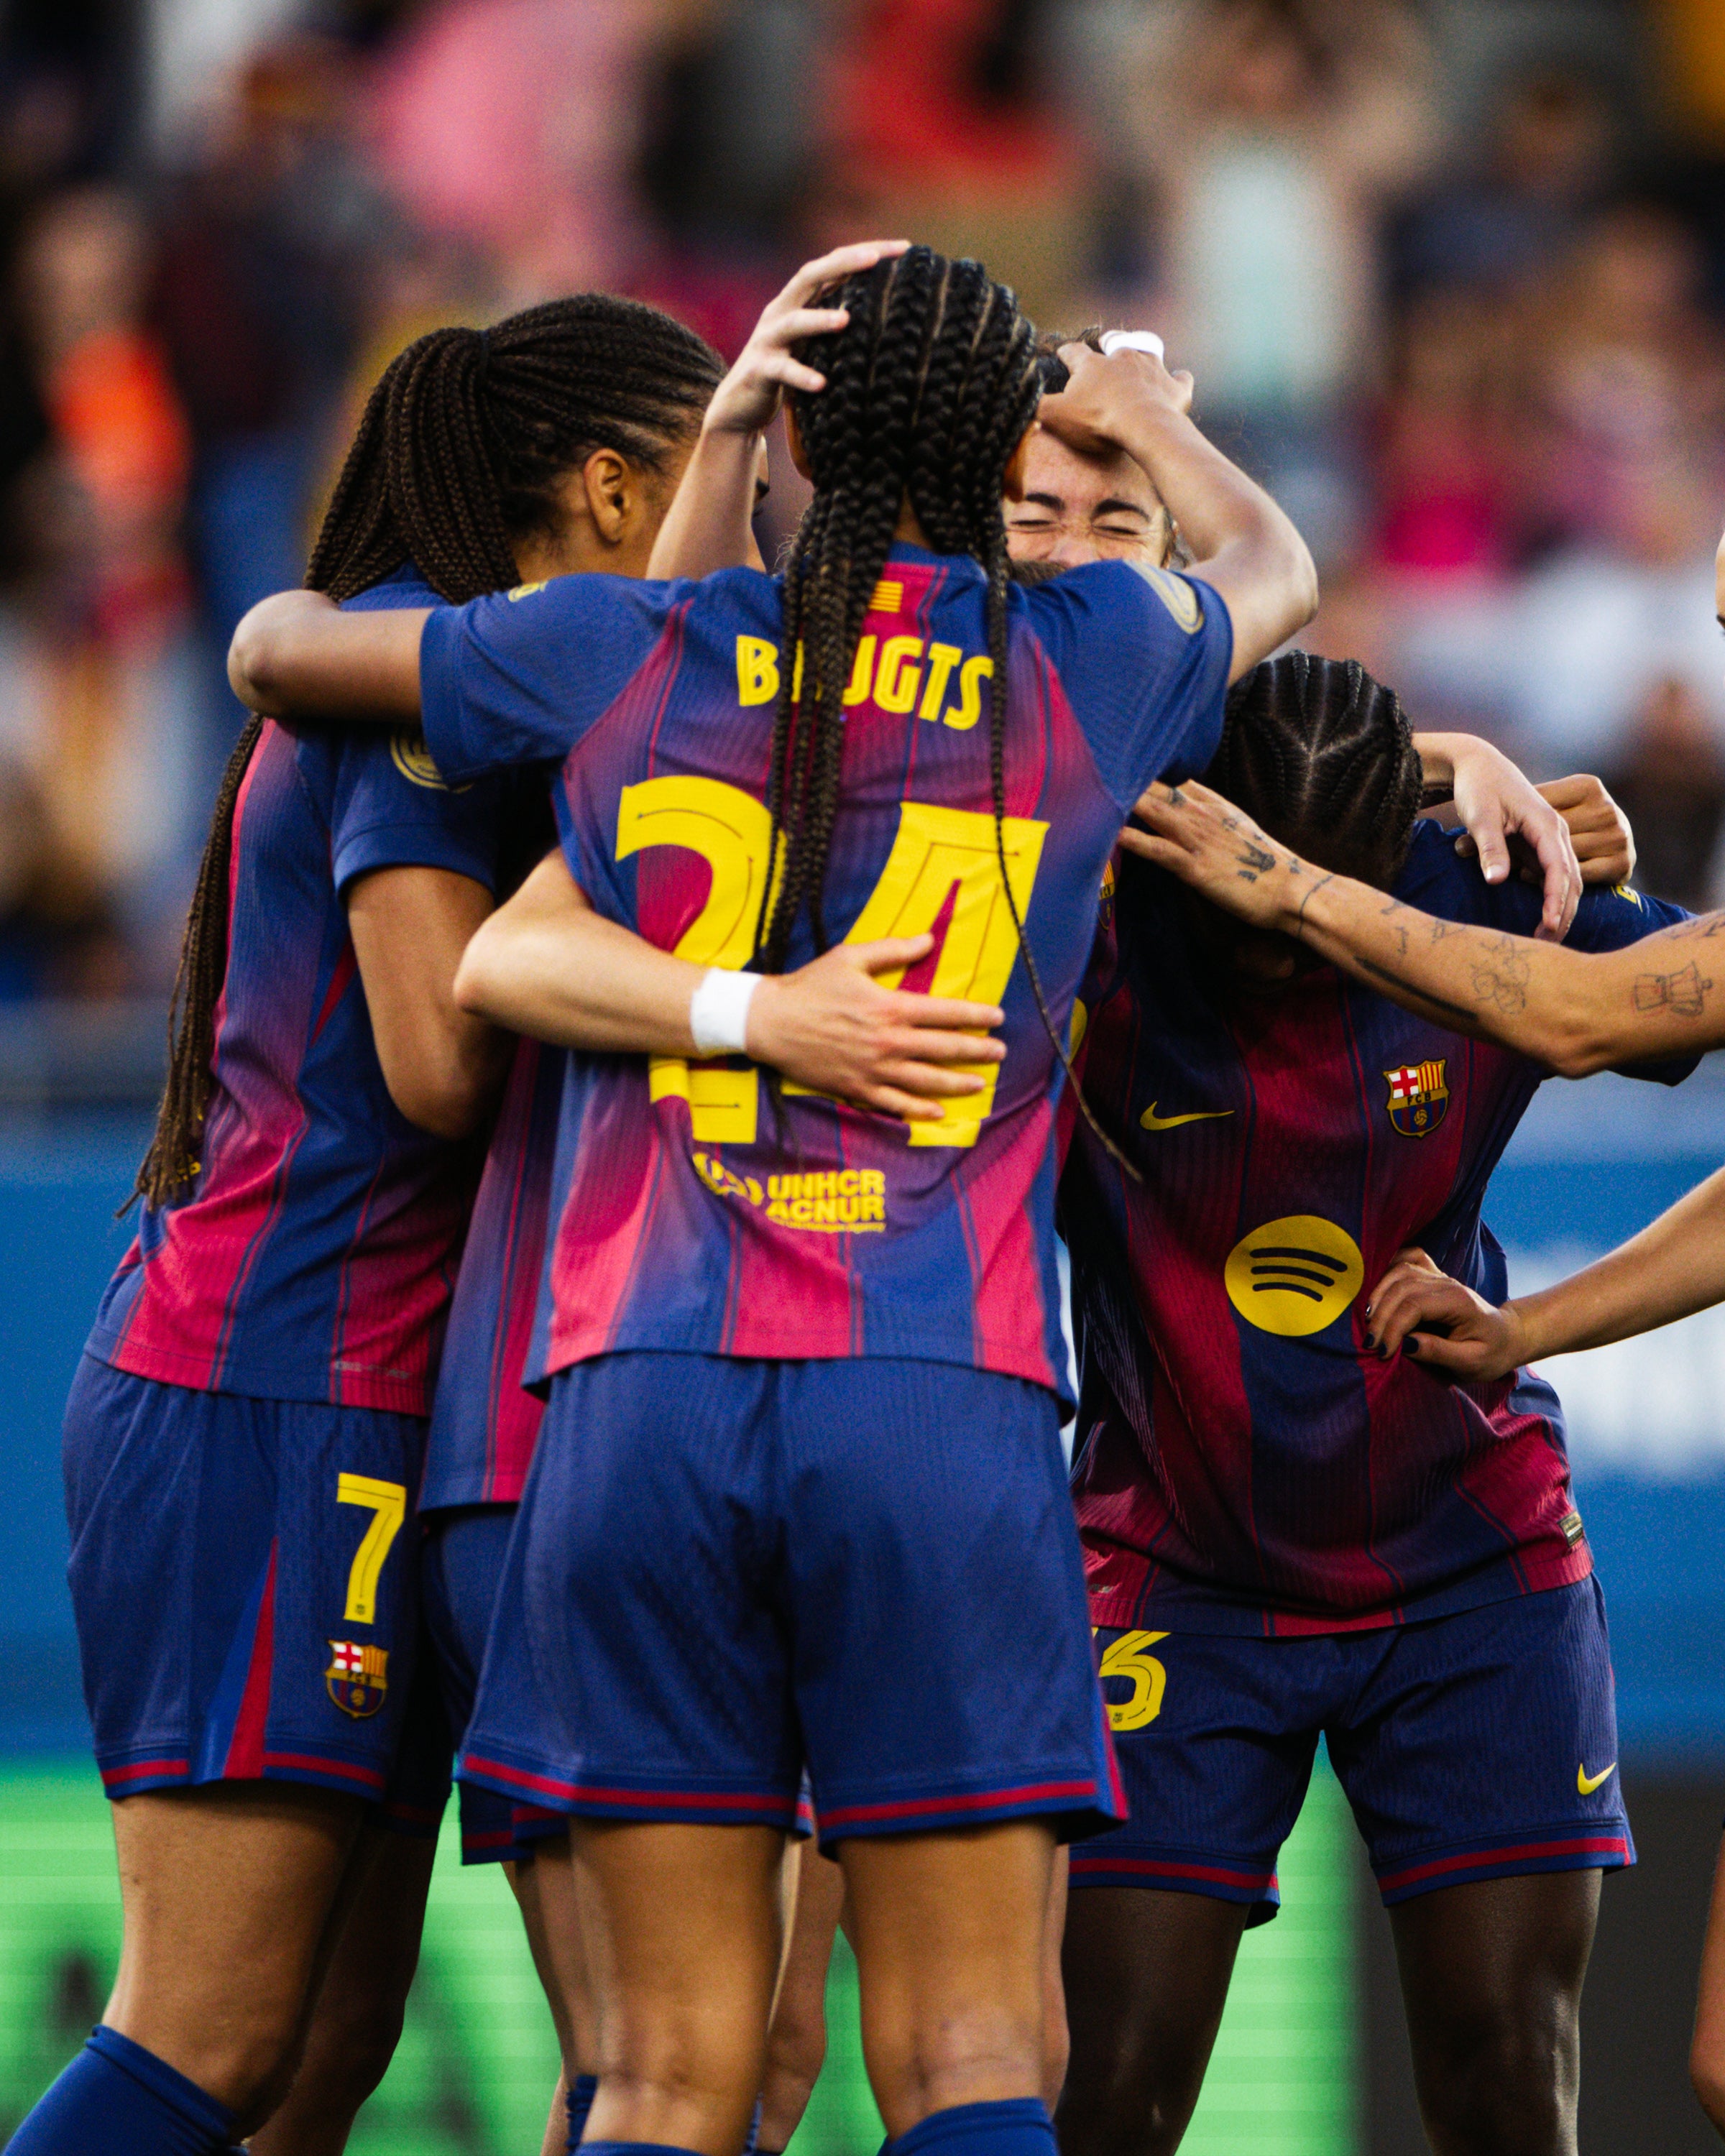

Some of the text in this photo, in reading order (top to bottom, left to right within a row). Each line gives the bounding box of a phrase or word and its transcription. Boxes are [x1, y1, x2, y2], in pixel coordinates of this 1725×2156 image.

[615, 775, 1050, 1148] 24
[1407, 1092, 1432, 1106] FCB
[767, 1169, 886, 1199] UNHCR
[765, 1196, 886, 1222] ACNUR
[337, 1473, 407, 1624] 7
